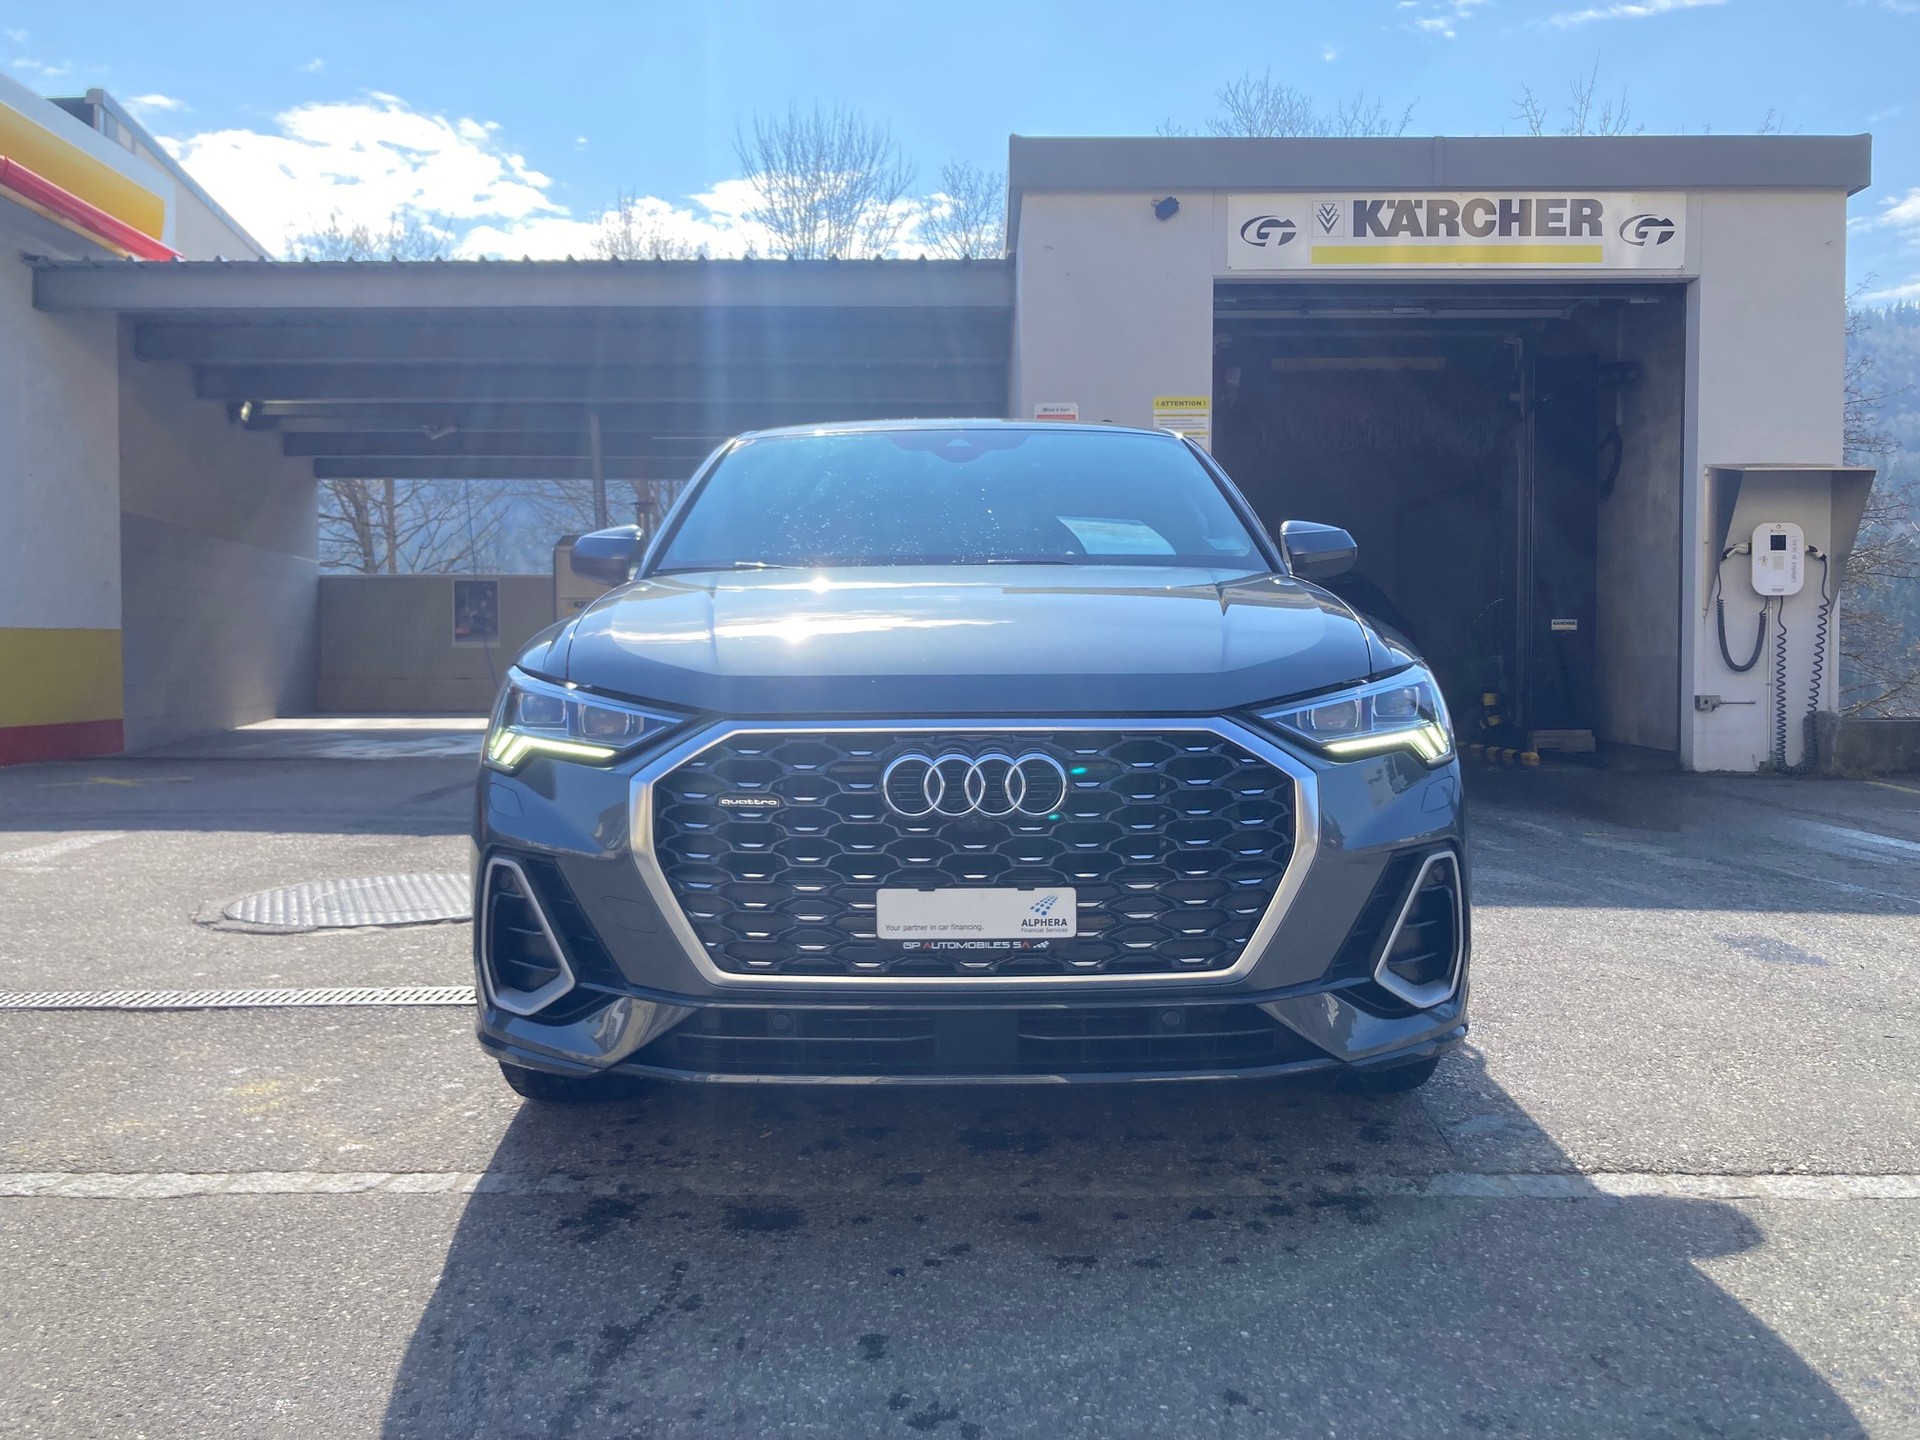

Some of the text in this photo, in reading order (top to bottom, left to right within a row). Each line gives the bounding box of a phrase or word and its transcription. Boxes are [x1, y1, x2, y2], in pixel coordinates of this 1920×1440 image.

[1352, 198, 1604, 238] KÄRCHER
[721, 798, 777, 806] quattro
[1021, 918, 1068, 927] ALPHERA
[902, 924, 928, 932] partner
[950, 923, 985, 931] financing.
[902, 941, 920, 949] GP
[923, 941, 1010, 949] AUTOMOBILES
